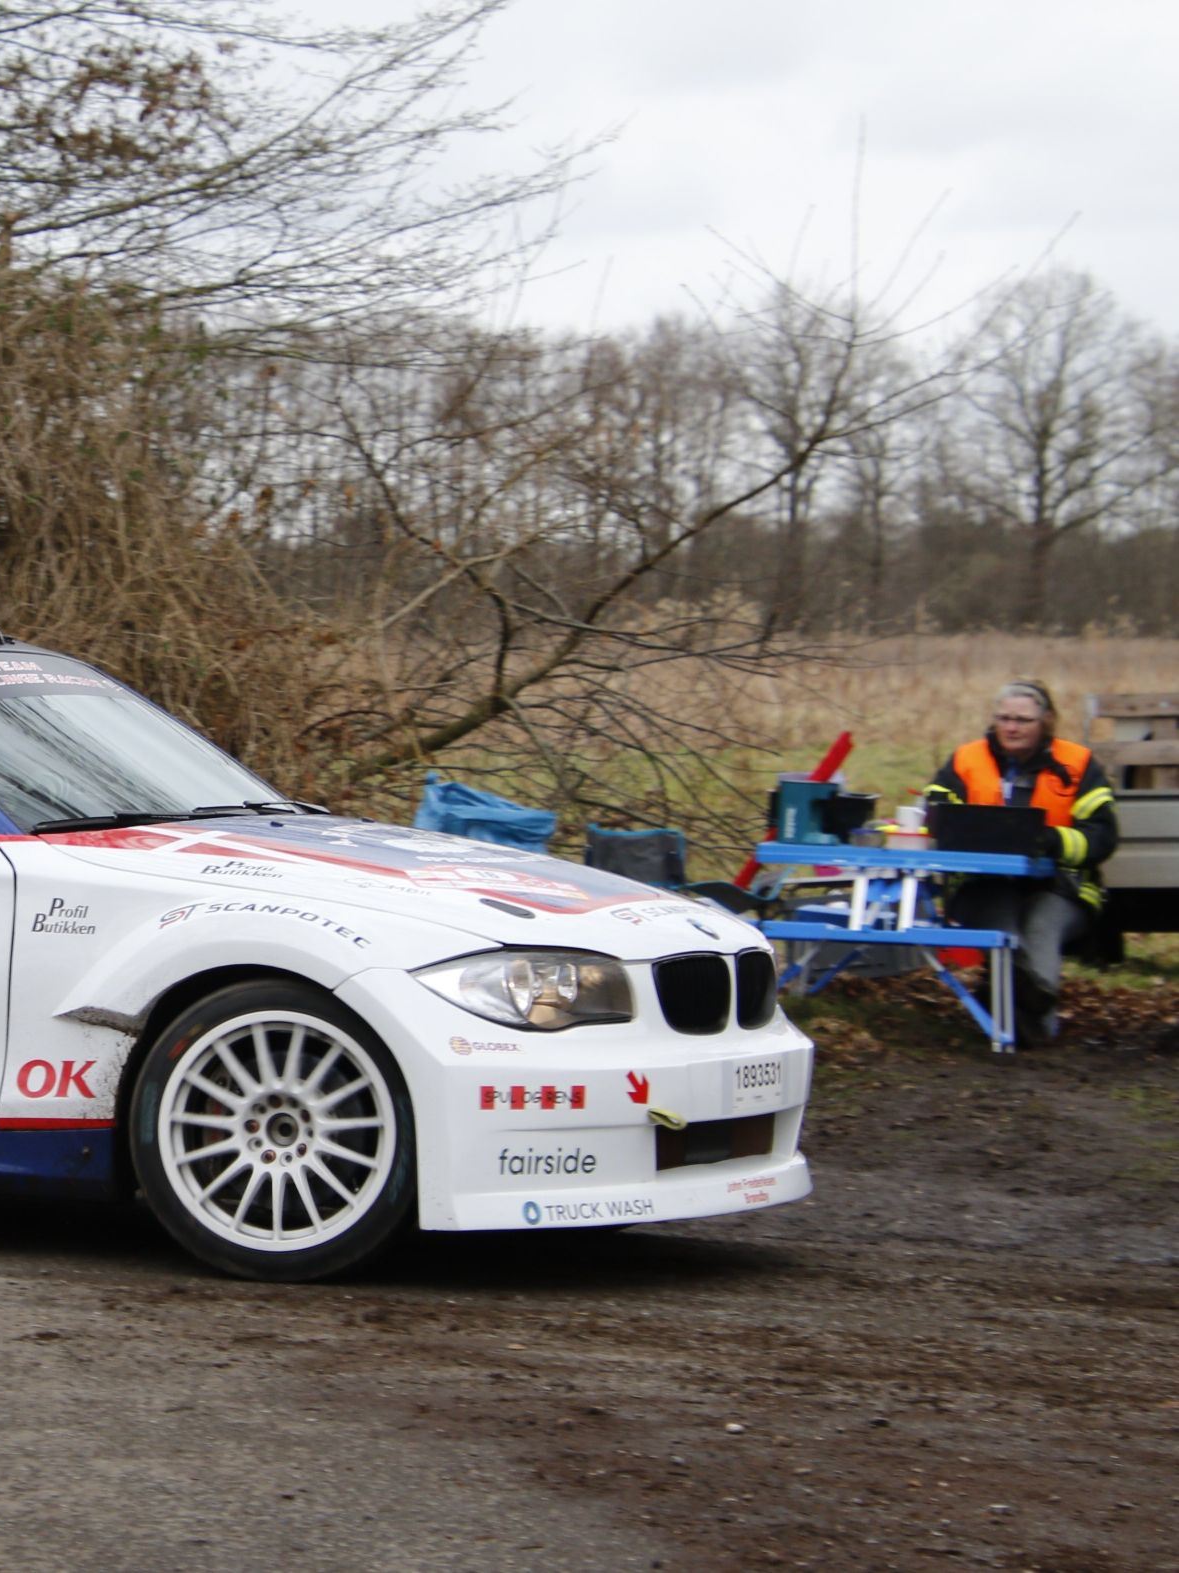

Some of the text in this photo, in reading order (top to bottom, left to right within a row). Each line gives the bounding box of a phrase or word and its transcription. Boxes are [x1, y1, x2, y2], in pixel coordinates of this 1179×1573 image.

[201, 864, 284, 879] Butikken
[48, 897, 88, 918] Profil
[31, 913, 96, 935] Butikken
[205, 902, 372, 949] SCANPOTEC
[472, 1042, 518, 1051] GLOBEX
[16, 1059, 97, 1099] OK
[735, 1062, 781, 1089] 1893531
[498, 1147, 597, 1175] fairside
[544, 1199, 655, 1221] TRUCK WASH
